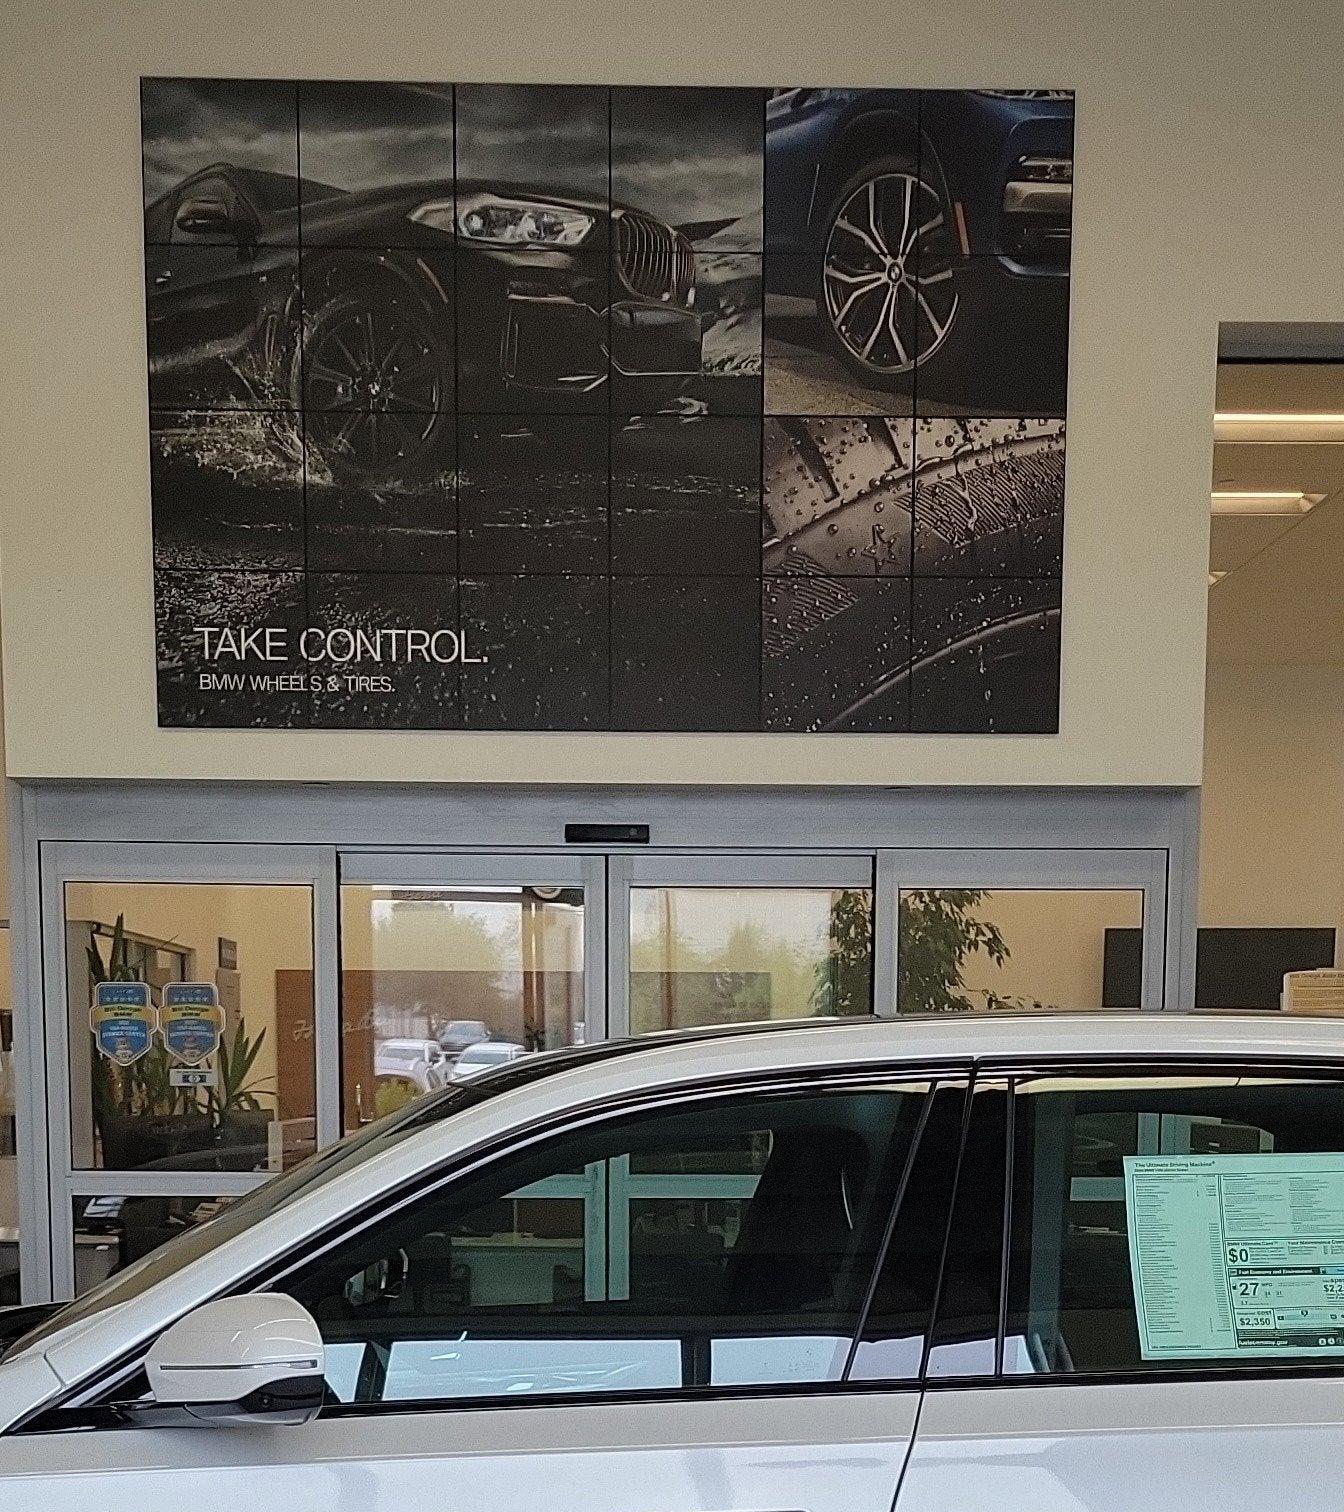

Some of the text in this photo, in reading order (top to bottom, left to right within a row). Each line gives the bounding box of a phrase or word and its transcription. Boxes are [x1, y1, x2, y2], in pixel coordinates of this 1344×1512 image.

[194, 627, 489, 664] TAKE CONTROL.
[199, 674, 396, 693] BMW WHEELS & TIRES.
[1228, 1247, 1249, 1264] $0
[1239, 1282, 1259, 1297] 27
[1239, 1317, 1271, 1327] $2,350
